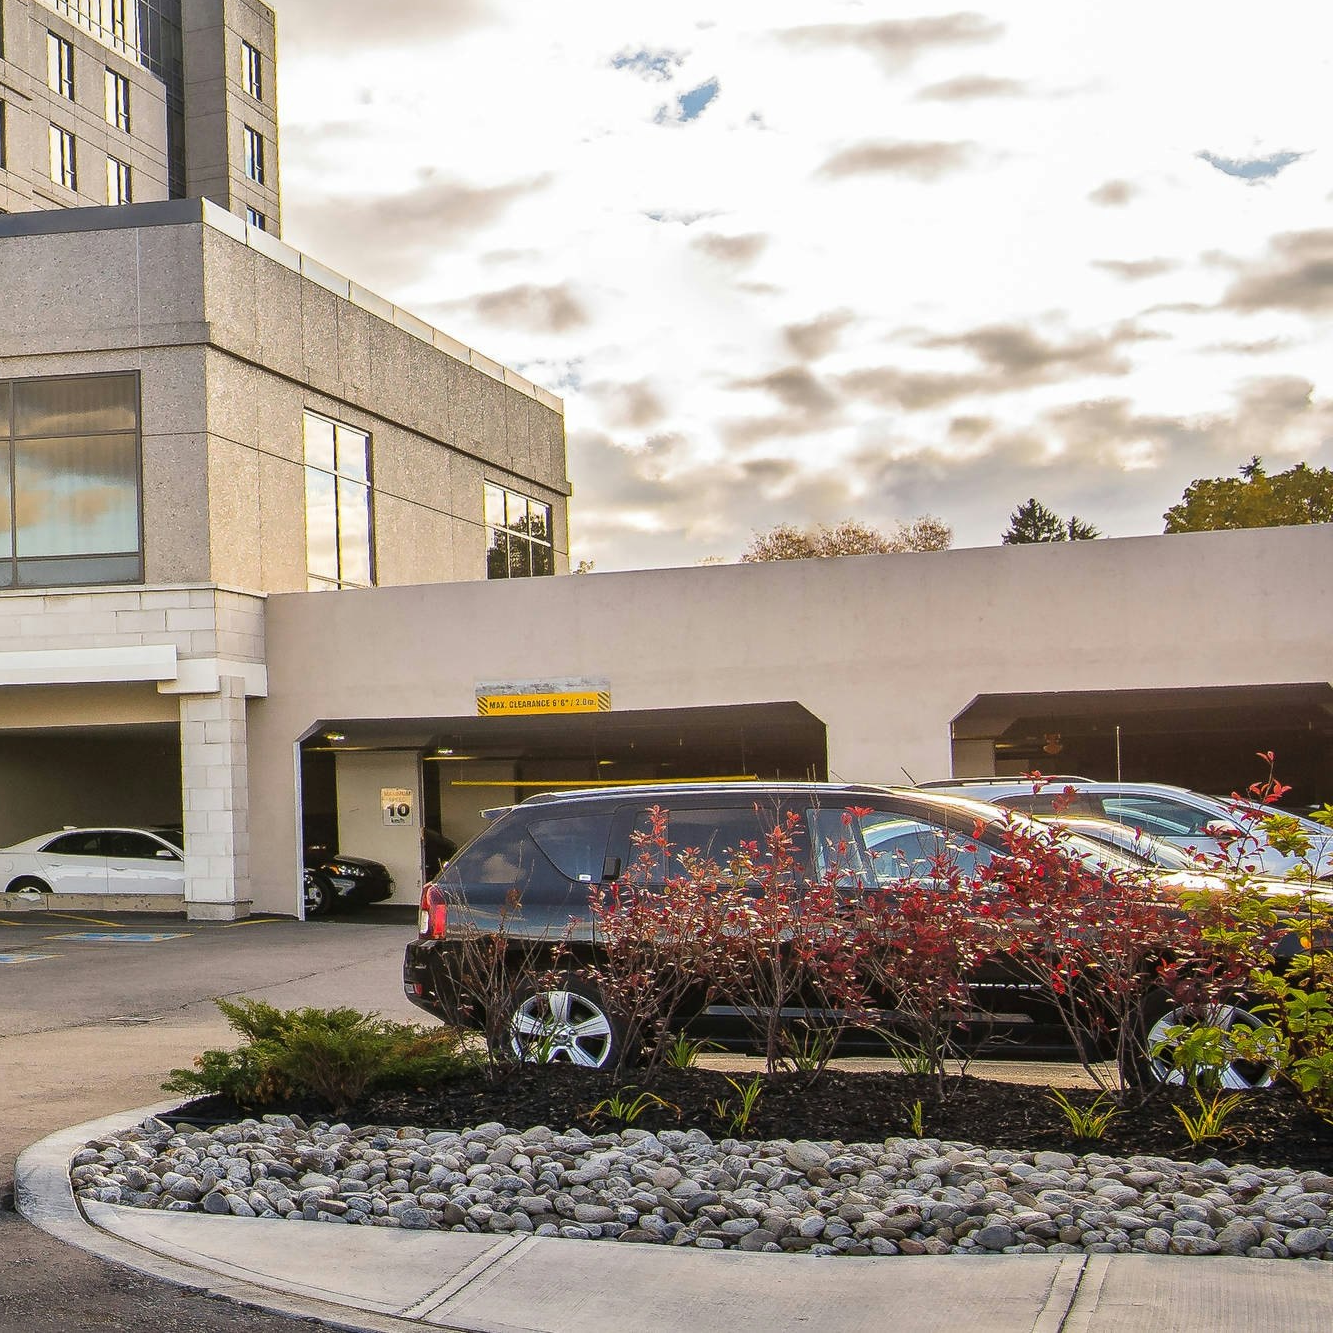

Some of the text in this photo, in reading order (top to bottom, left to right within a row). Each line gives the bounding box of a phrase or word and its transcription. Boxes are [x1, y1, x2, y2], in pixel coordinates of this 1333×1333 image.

[489, 701, 507, 709] MAX.
[509, 699, 550, 709] CLEARANCE
[387, 803, 410, 817] 10
